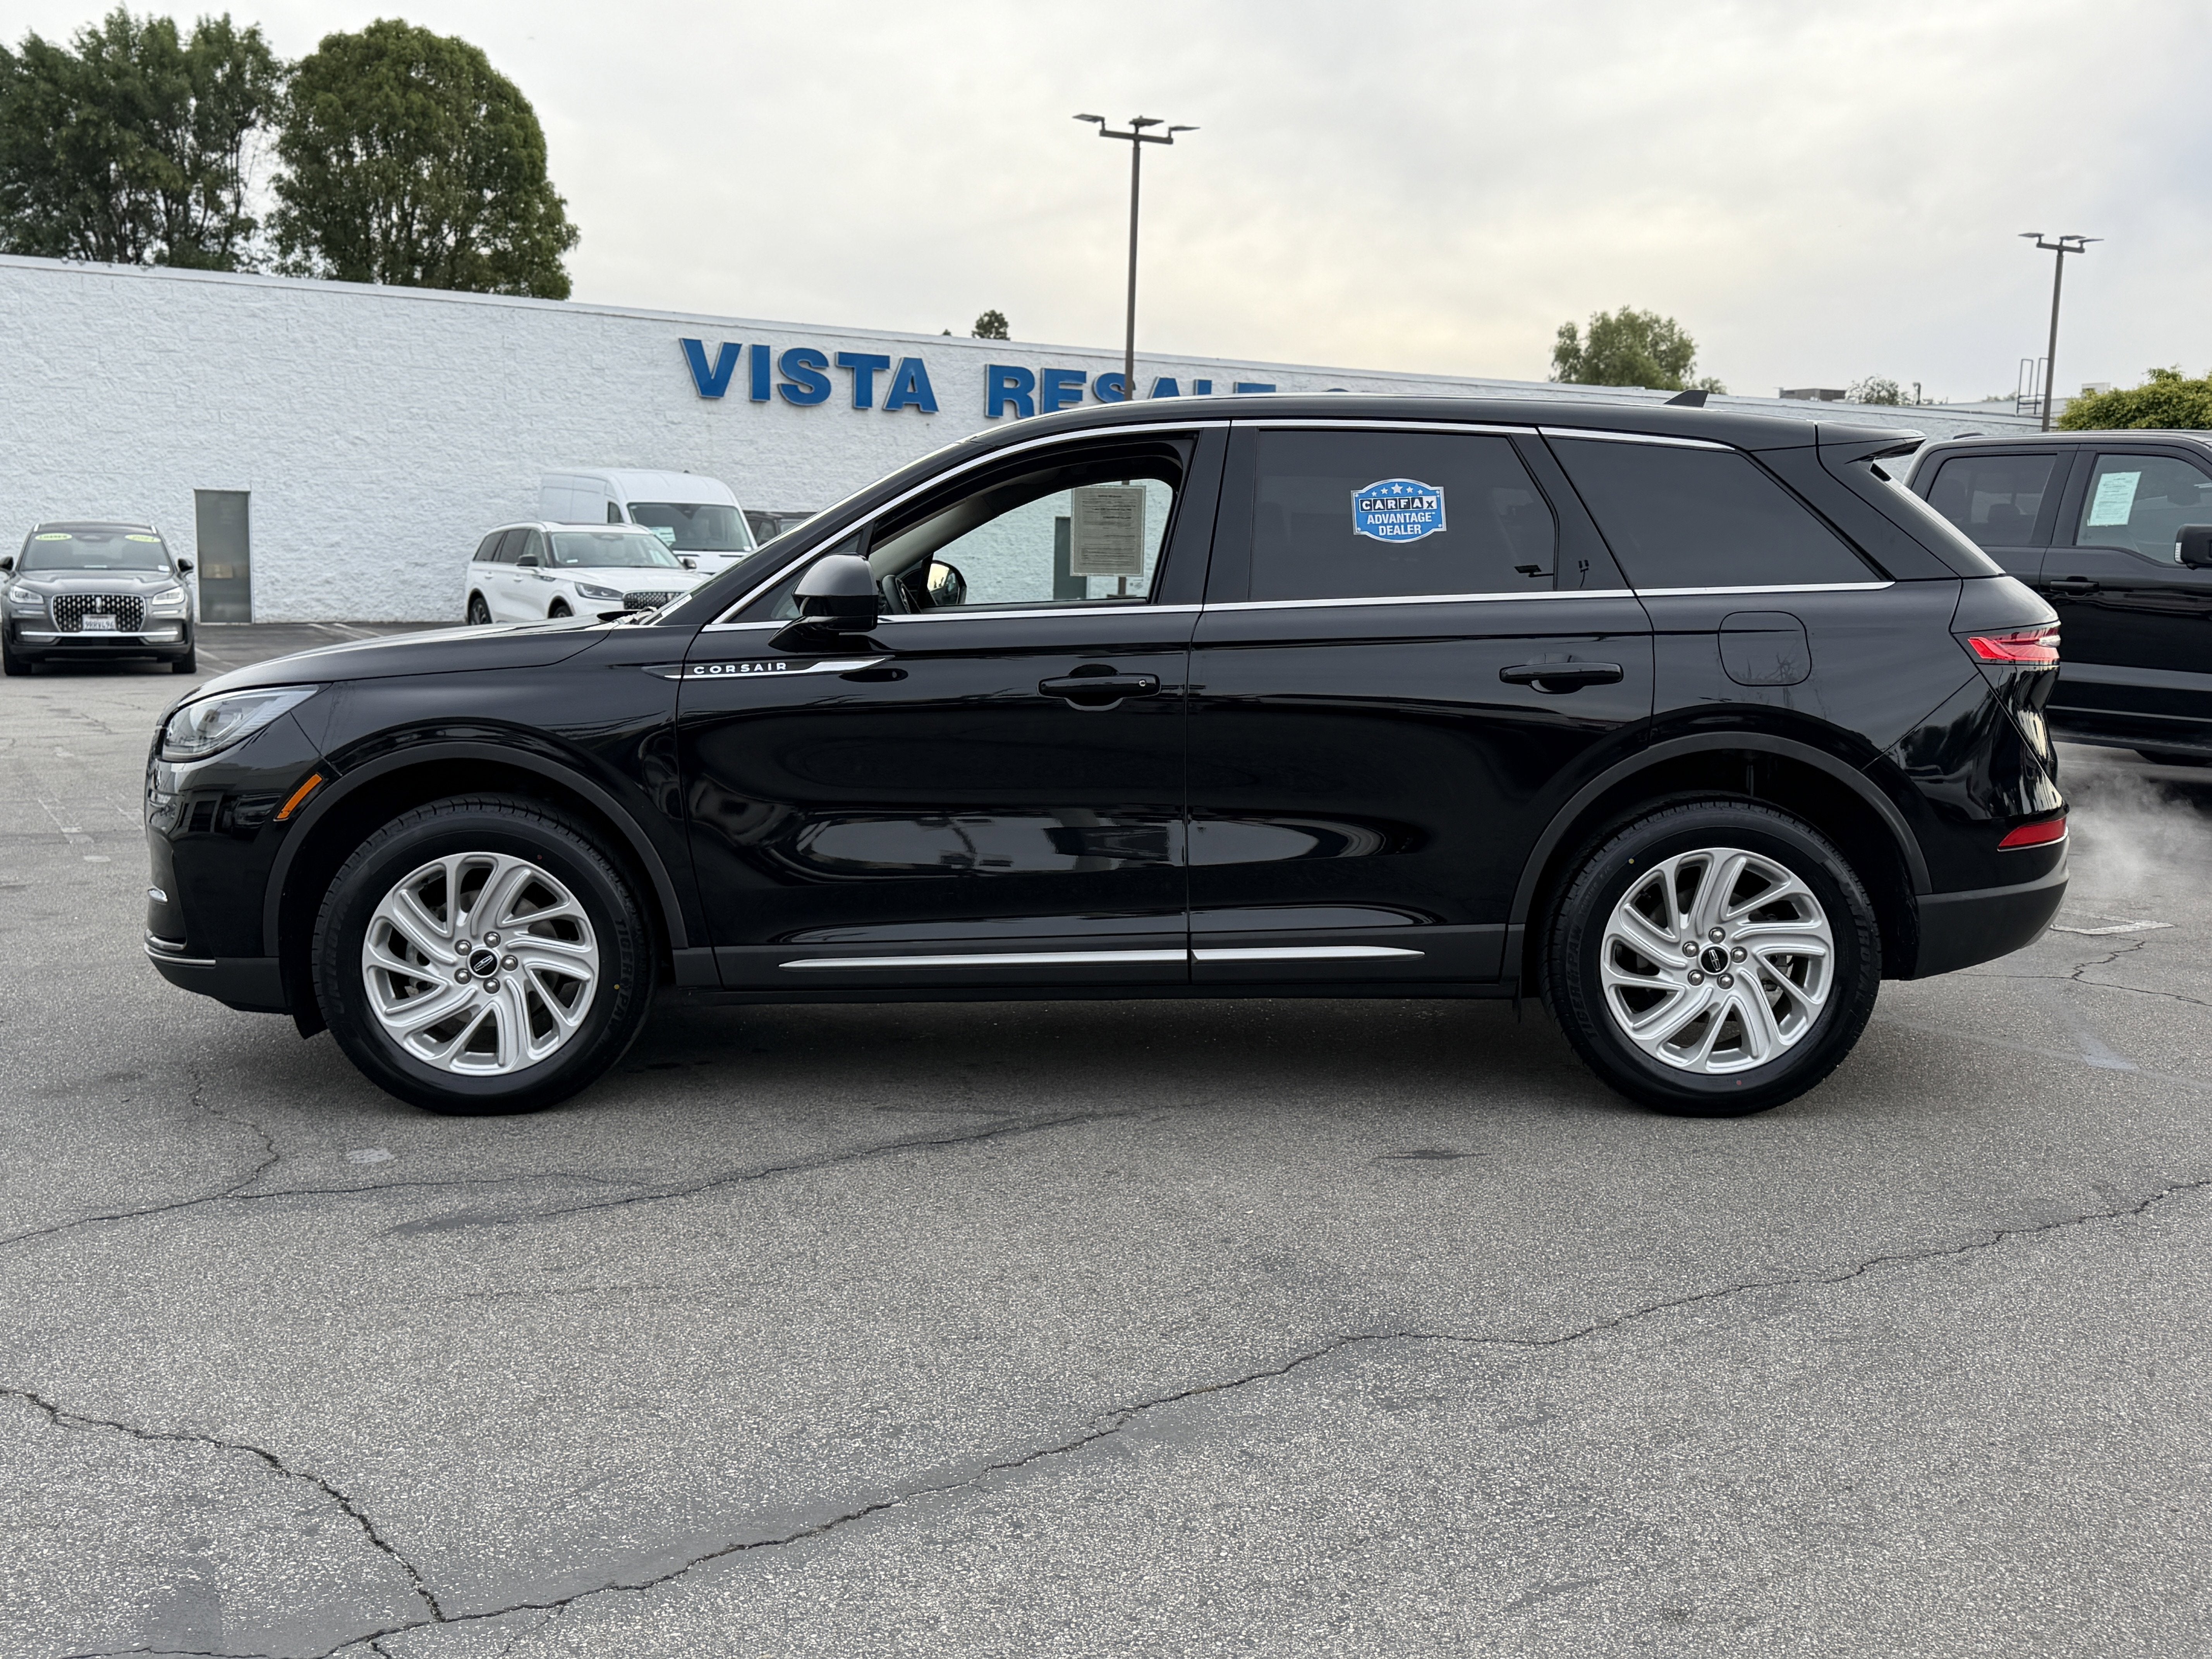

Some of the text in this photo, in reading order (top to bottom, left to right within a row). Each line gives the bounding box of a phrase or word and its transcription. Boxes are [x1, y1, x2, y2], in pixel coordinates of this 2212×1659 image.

[680, 337, 1276, 418] VISTA RES
[1362, 498, 1434, 510] CARFAX
[1367, 512, 1432, 524] ADVANTAGE
[1379, 524, 1422, 536] DEALER
[693, 662, 787, 675] CORSAIR
[615, 918, 633, 976] TIGER
[1838, 881, 1871, 1003] UNIROYAL
[1567, 924, 1599, 1039] TIGER PAW
